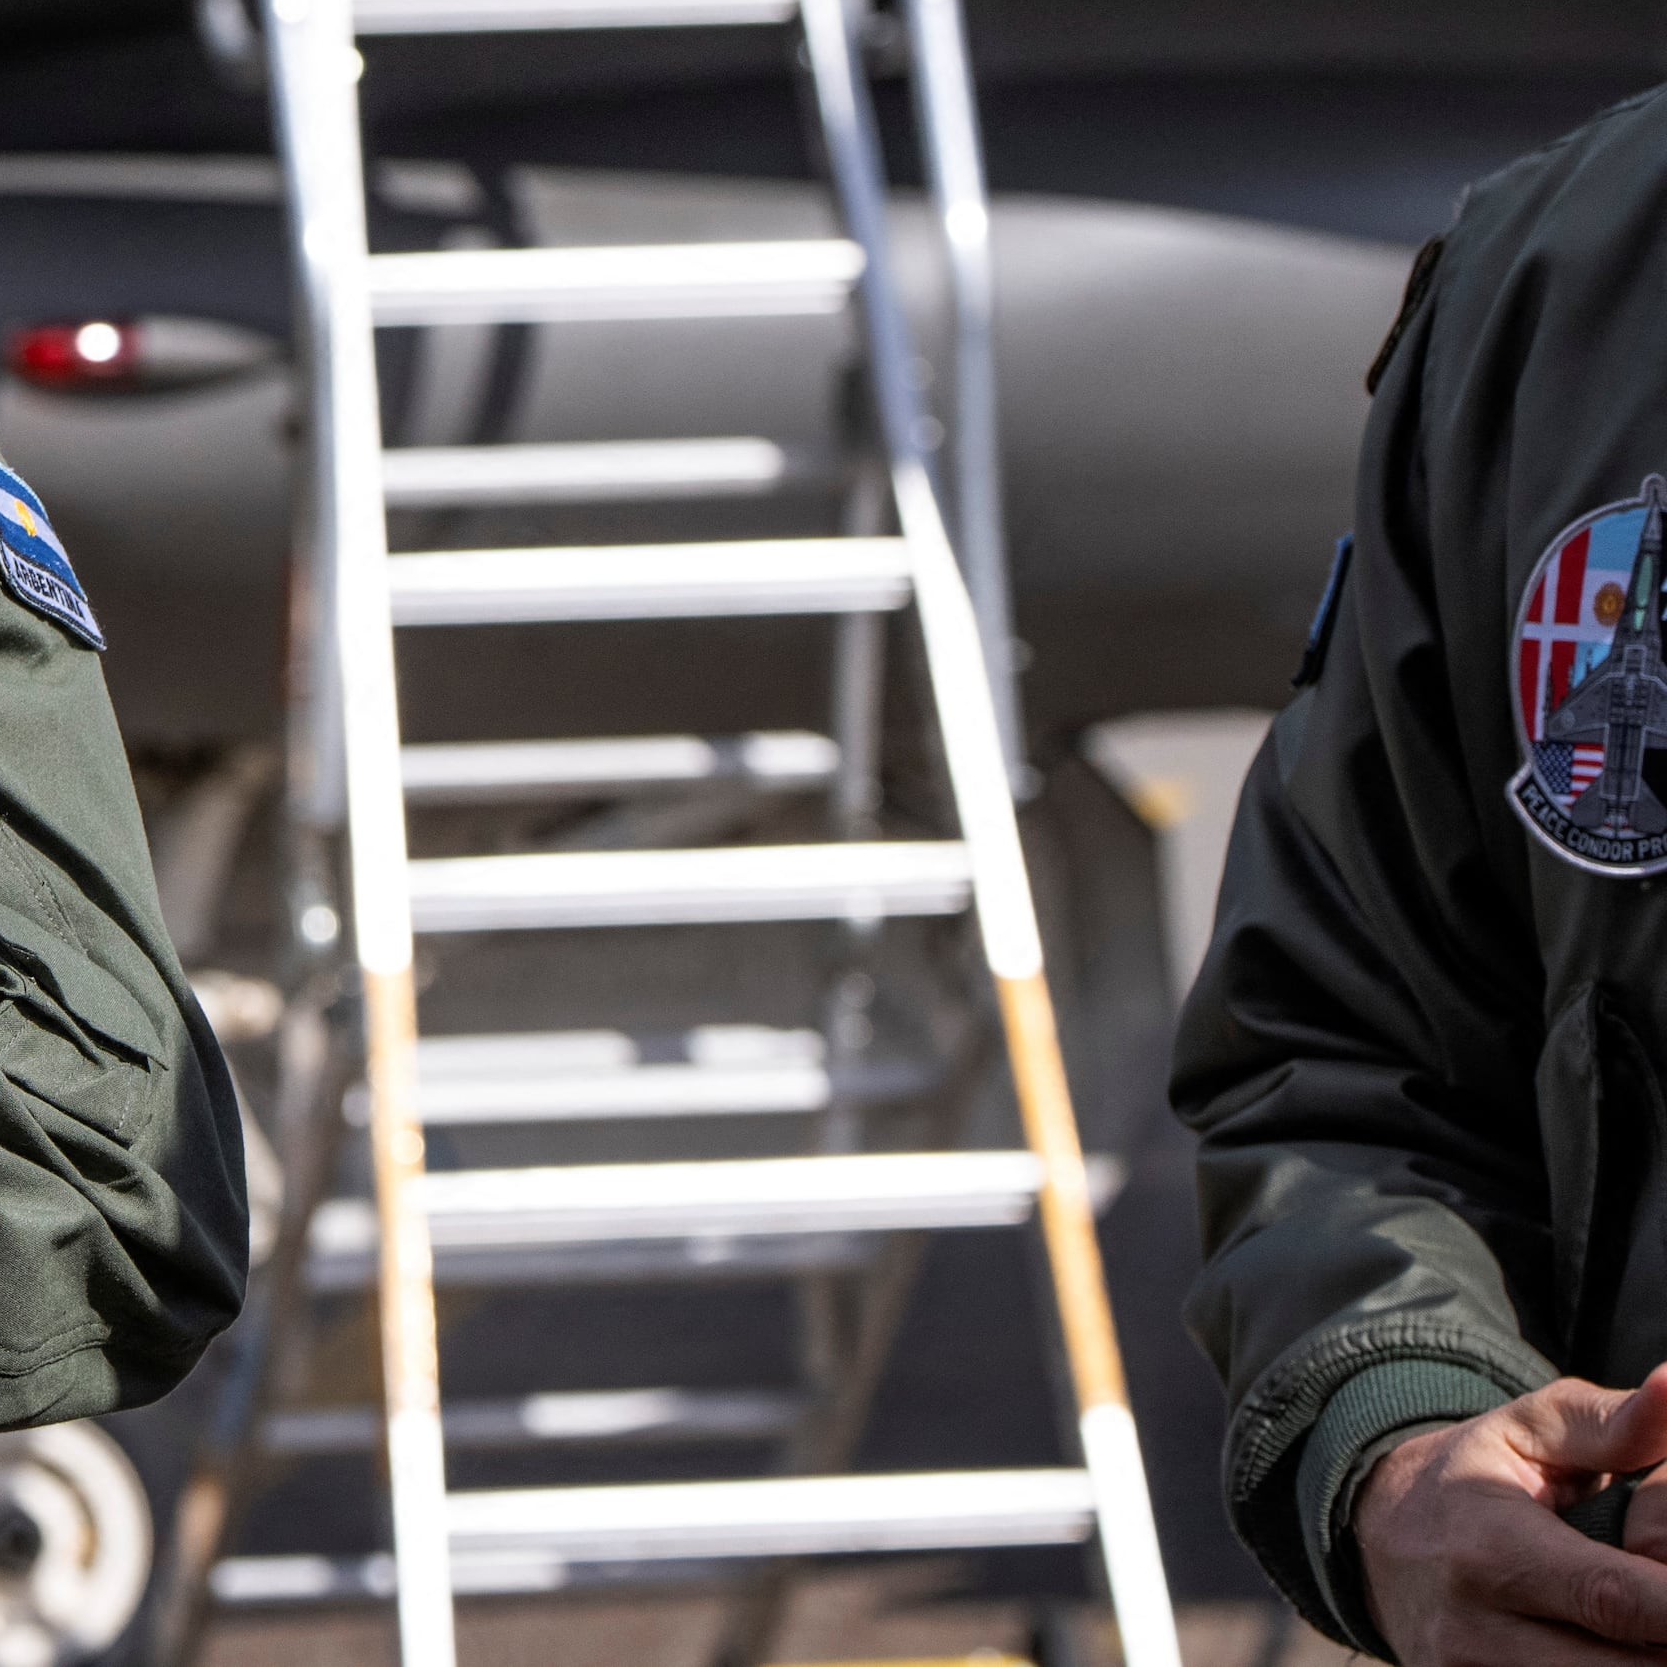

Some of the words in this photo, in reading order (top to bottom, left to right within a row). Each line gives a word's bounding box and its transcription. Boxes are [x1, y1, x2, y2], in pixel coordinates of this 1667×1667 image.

[14, 558, 85, 620] ARGENTINA
[1521, 785, 1569, 839] PEACE
[1568, 828, 1633, 861] CONDOR
